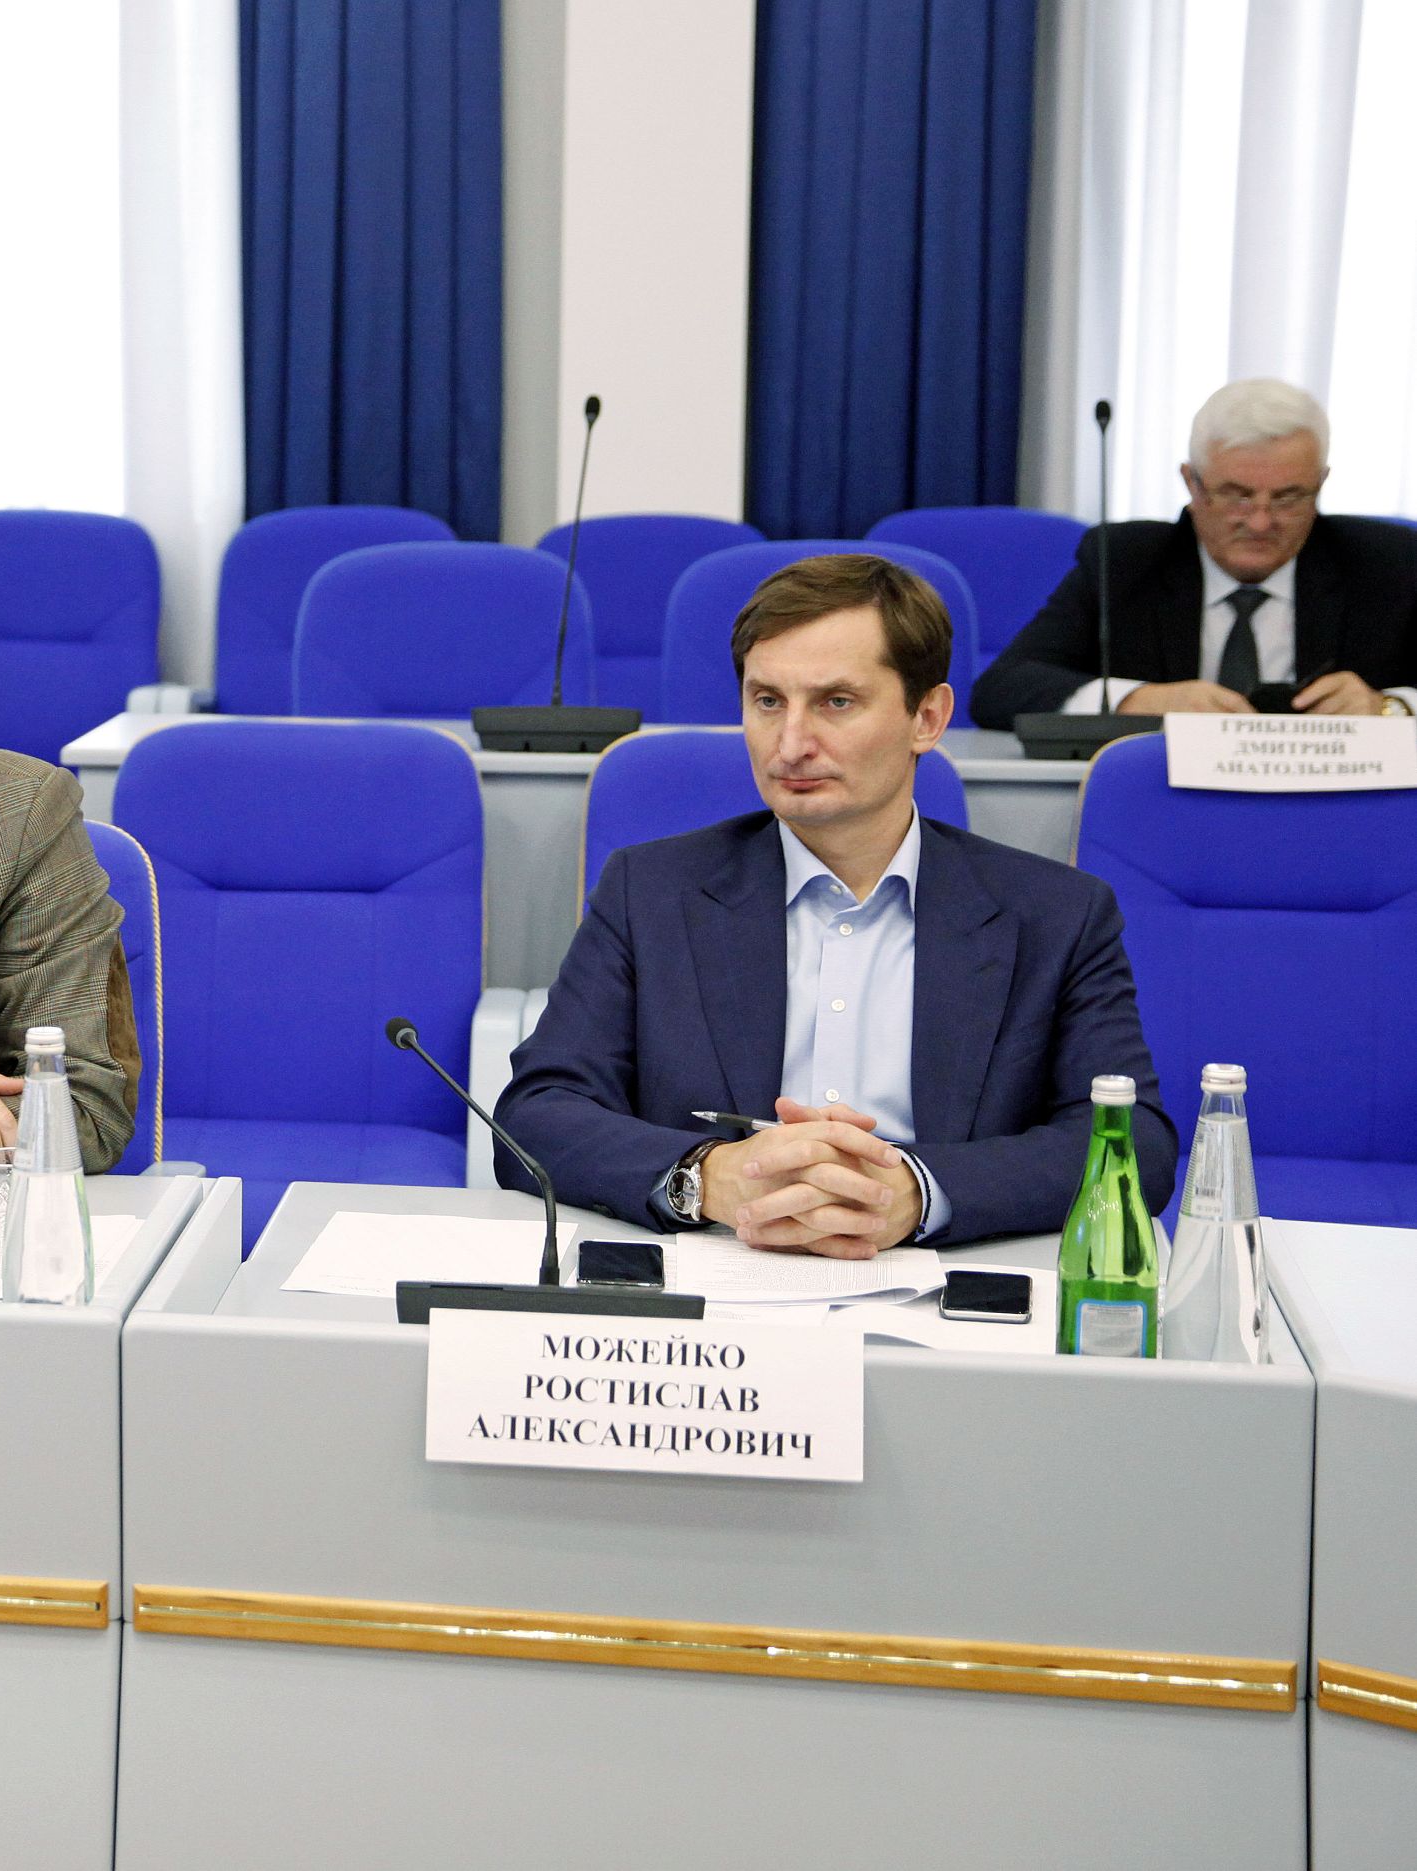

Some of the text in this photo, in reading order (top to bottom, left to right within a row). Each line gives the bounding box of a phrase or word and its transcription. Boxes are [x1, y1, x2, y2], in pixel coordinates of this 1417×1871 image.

[1234, 737, 1348, 756] ДМИТРИЙ
[1214, 760, 1384, 776] АНАТОЛЬЕВИЧ
[541, 1333, 747, 1370] МОЖЕЙКО
[523, 1373, 760, 1414] РОСТИСЛАВ
[467, 1413, 816, 1460] АЛЕКСАНДРОВИЧ
